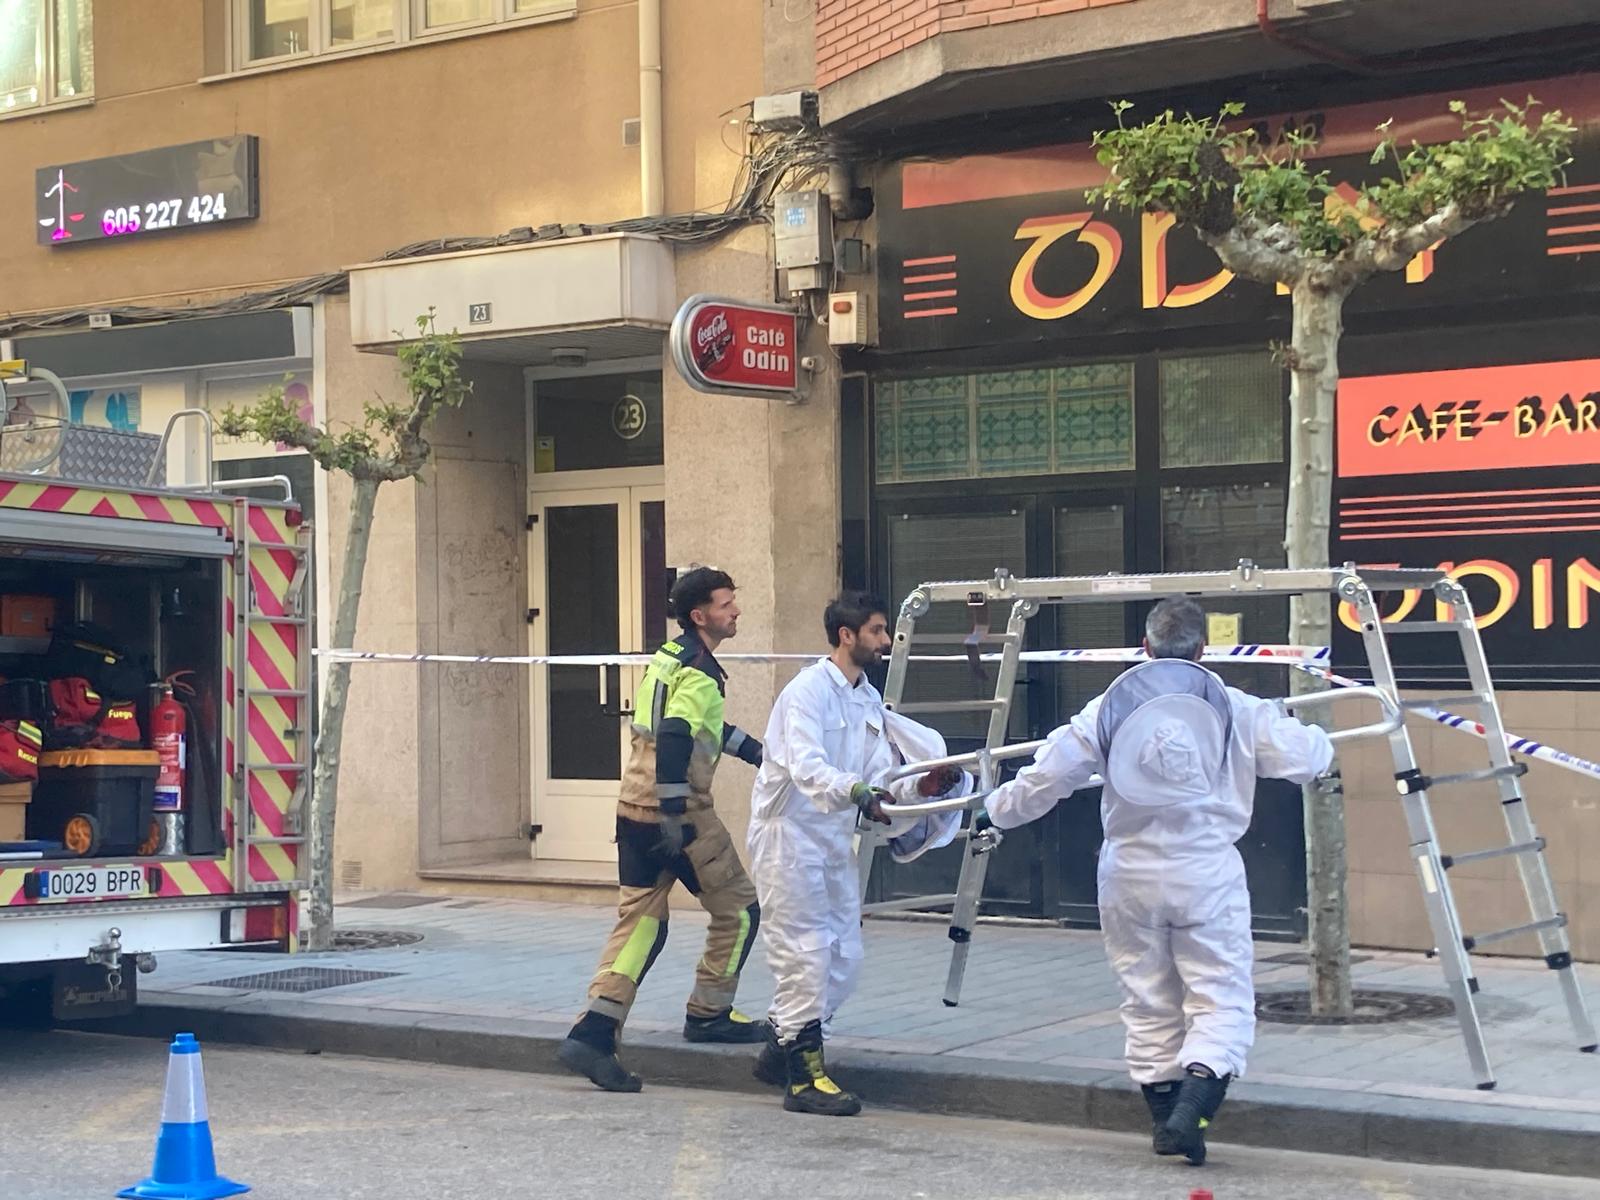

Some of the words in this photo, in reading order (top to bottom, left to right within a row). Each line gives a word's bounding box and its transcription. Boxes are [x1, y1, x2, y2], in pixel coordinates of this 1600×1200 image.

[102, 205, 141, 235] 605
[145, 199, 182, 230] 227
[187, 193, 226, 223] 424
[473, 305, 487, 321] 23
[746, 326, 785, 347] Café
[619, 404, 641, 429] 23
[1366, 390, 1600, 447] CAFE-BAR
[51, 872, 97, 895] 0029
[107, 869, 141, 893] BPR
